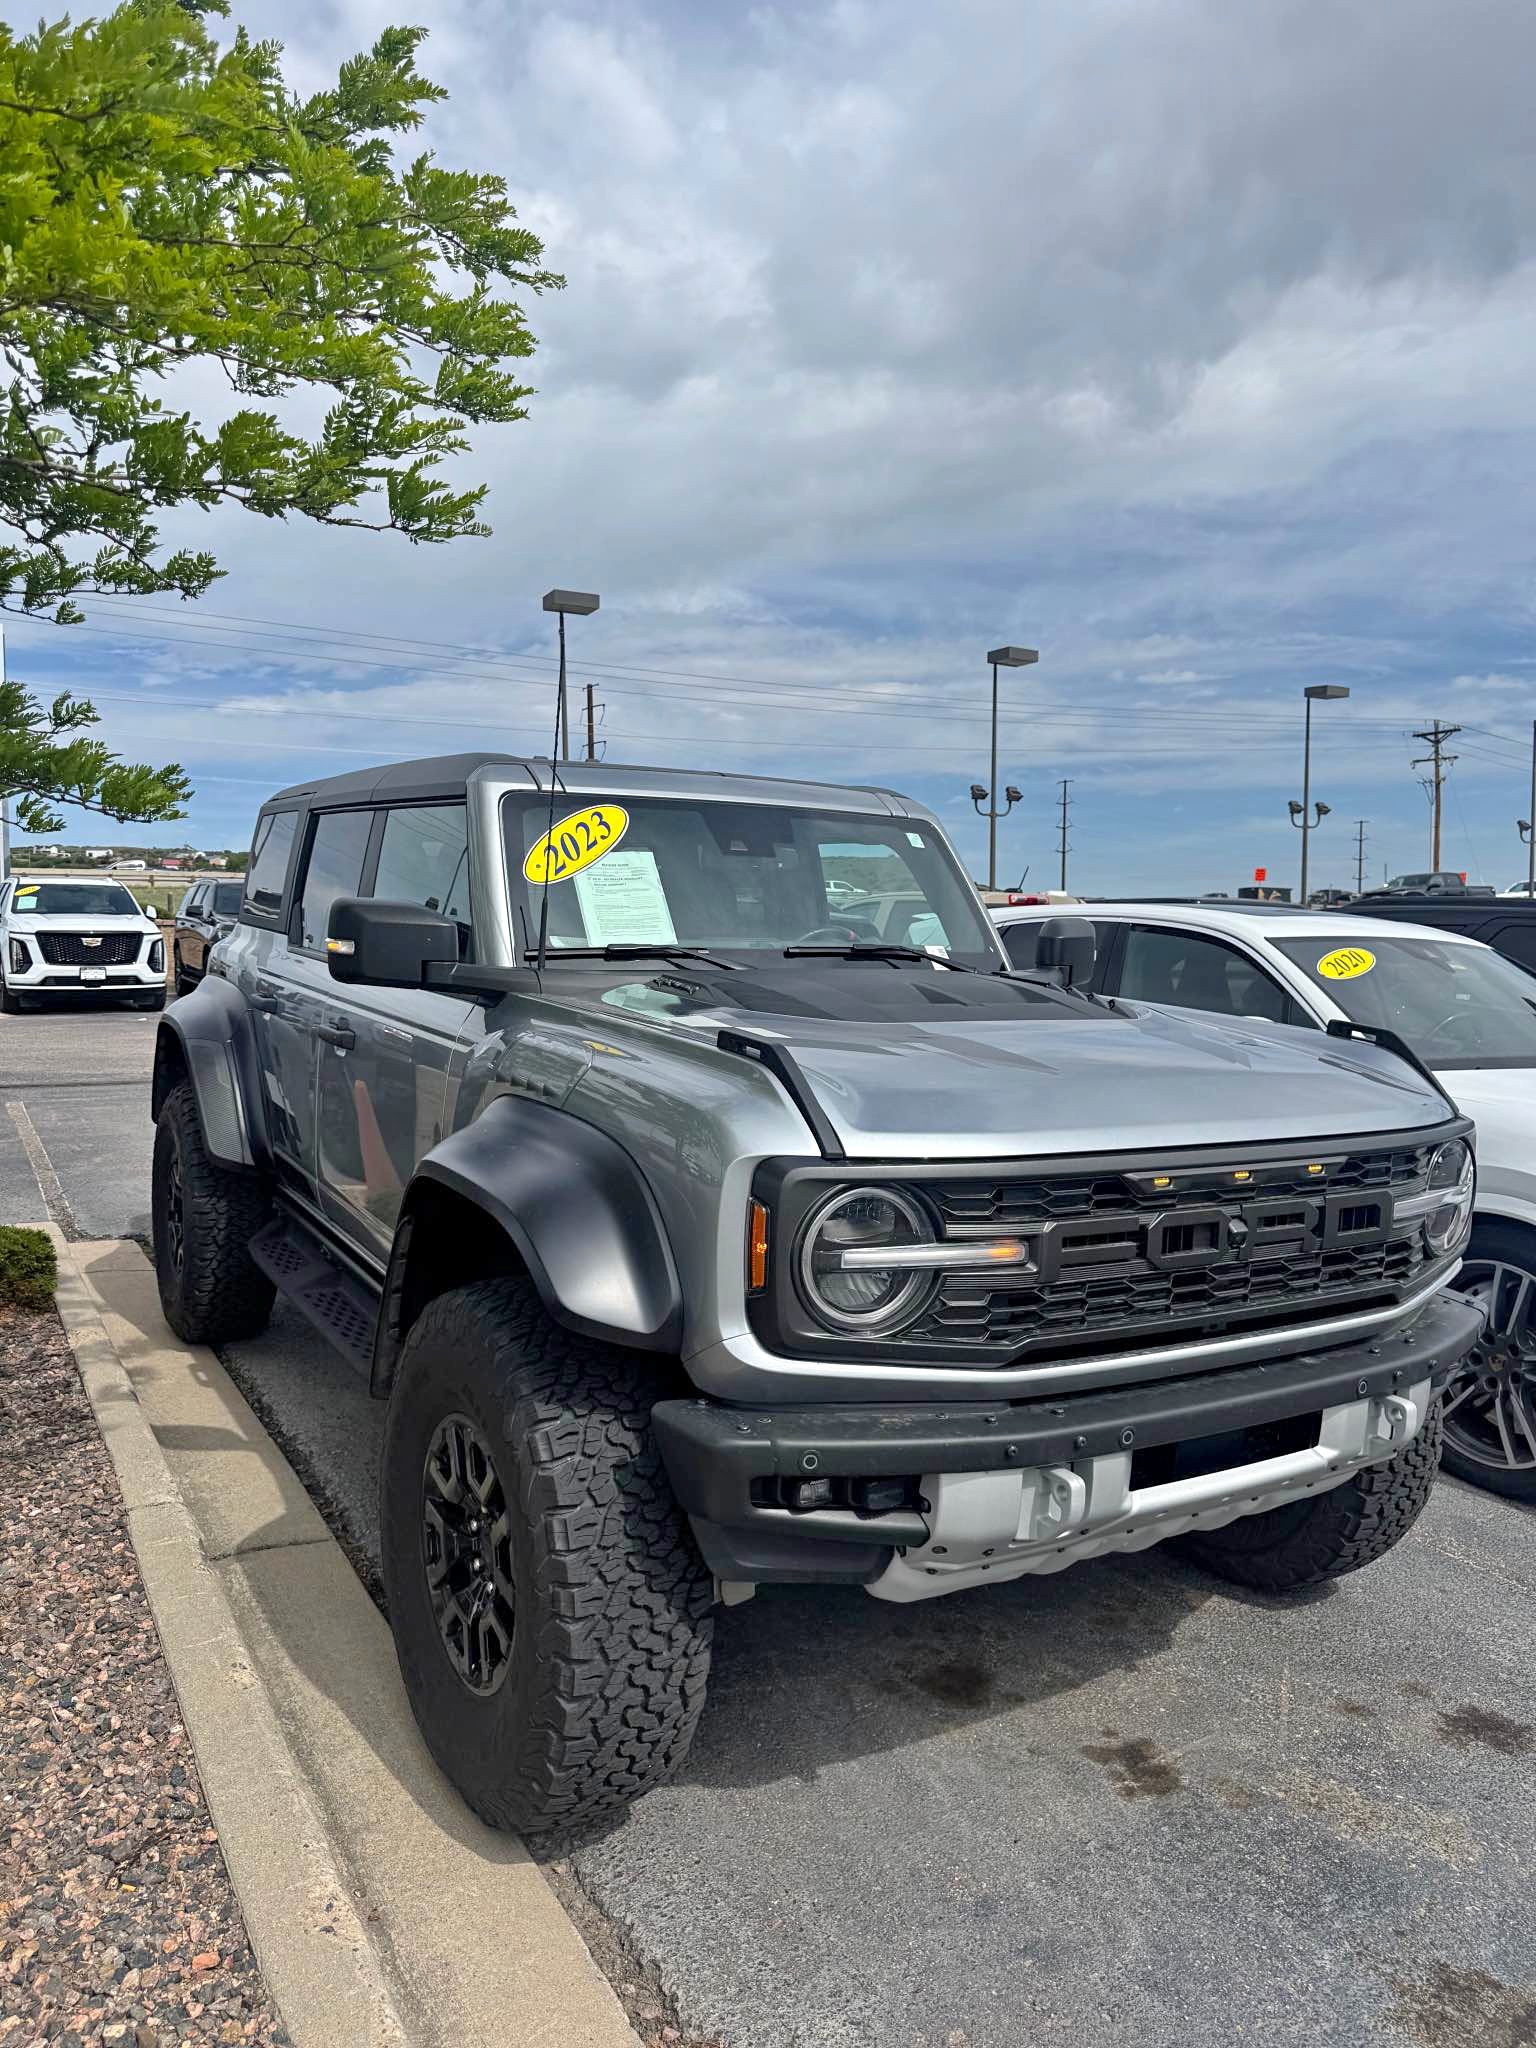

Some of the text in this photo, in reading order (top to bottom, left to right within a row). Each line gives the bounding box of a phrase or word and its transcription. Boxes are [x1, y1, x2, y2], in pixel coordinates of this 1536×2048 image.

[544, 811, 612, 877] 2023
[1326, 950, 1366, 976] 2020
[1039, 1189, 1394, 1282] FORD
